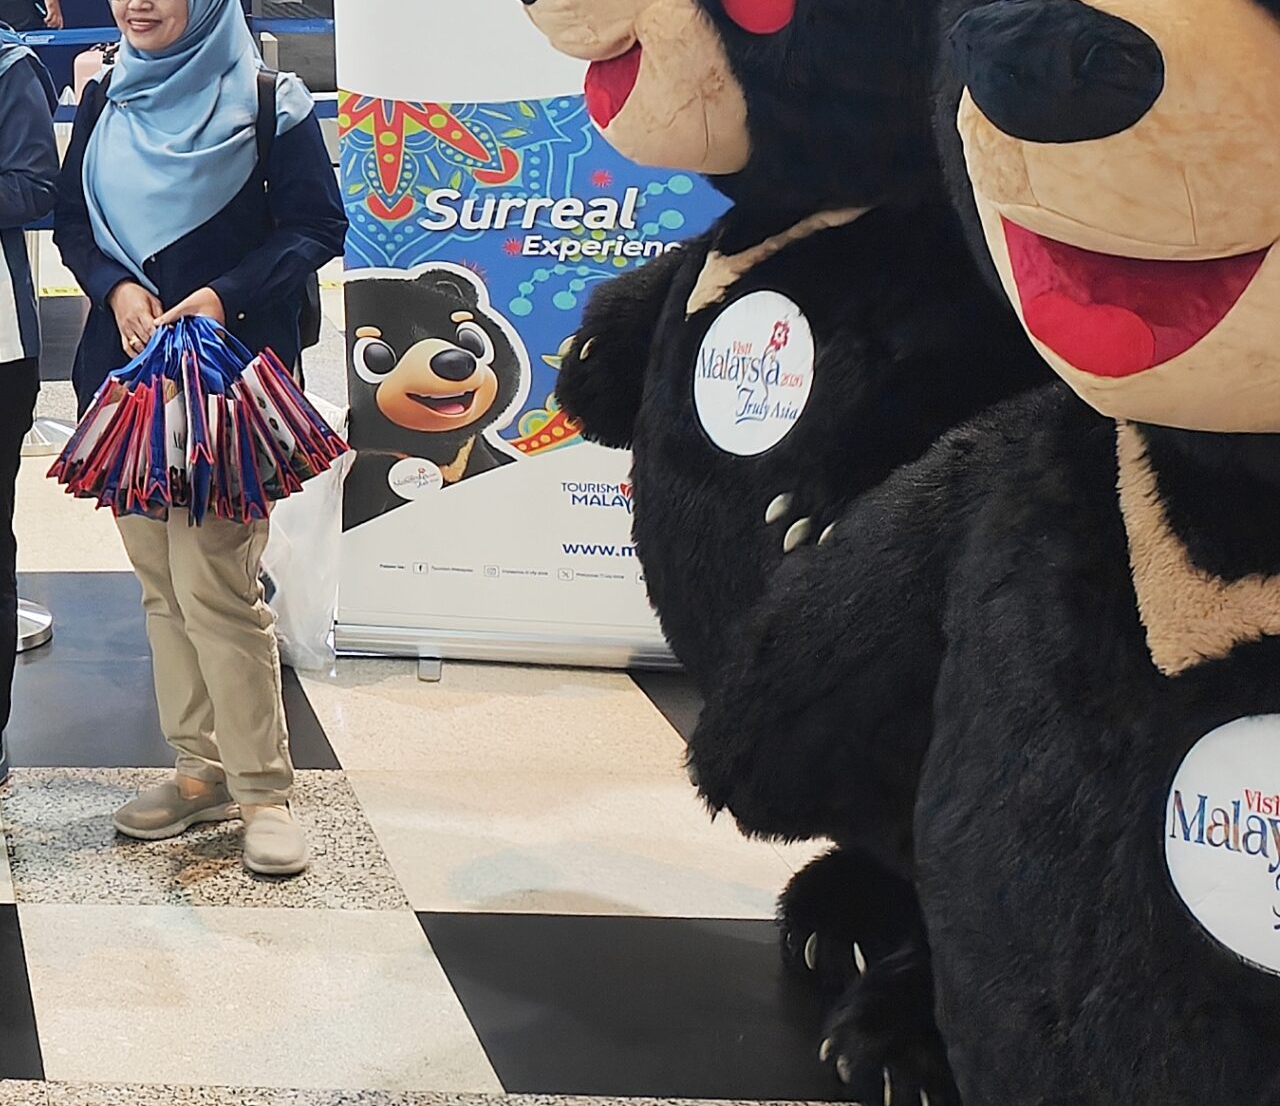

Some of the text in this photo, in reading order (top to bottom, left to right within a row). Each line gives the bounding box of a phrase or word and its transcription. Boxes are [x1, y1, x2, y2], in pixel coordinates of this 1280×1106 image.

[419, 187, 640, 232] Surreal
[521, 235, 683, 262] Experienc
[697, 345, 780, 392] Malaysia
[734, 387, 799, 424] Truly Asia
[561, 482, 620, 494] TOURISM
[572, 494, 631, 514] MALAY
[562, 543, 634, 557] www.m
[1245, 789, 1280, 816] Visi
